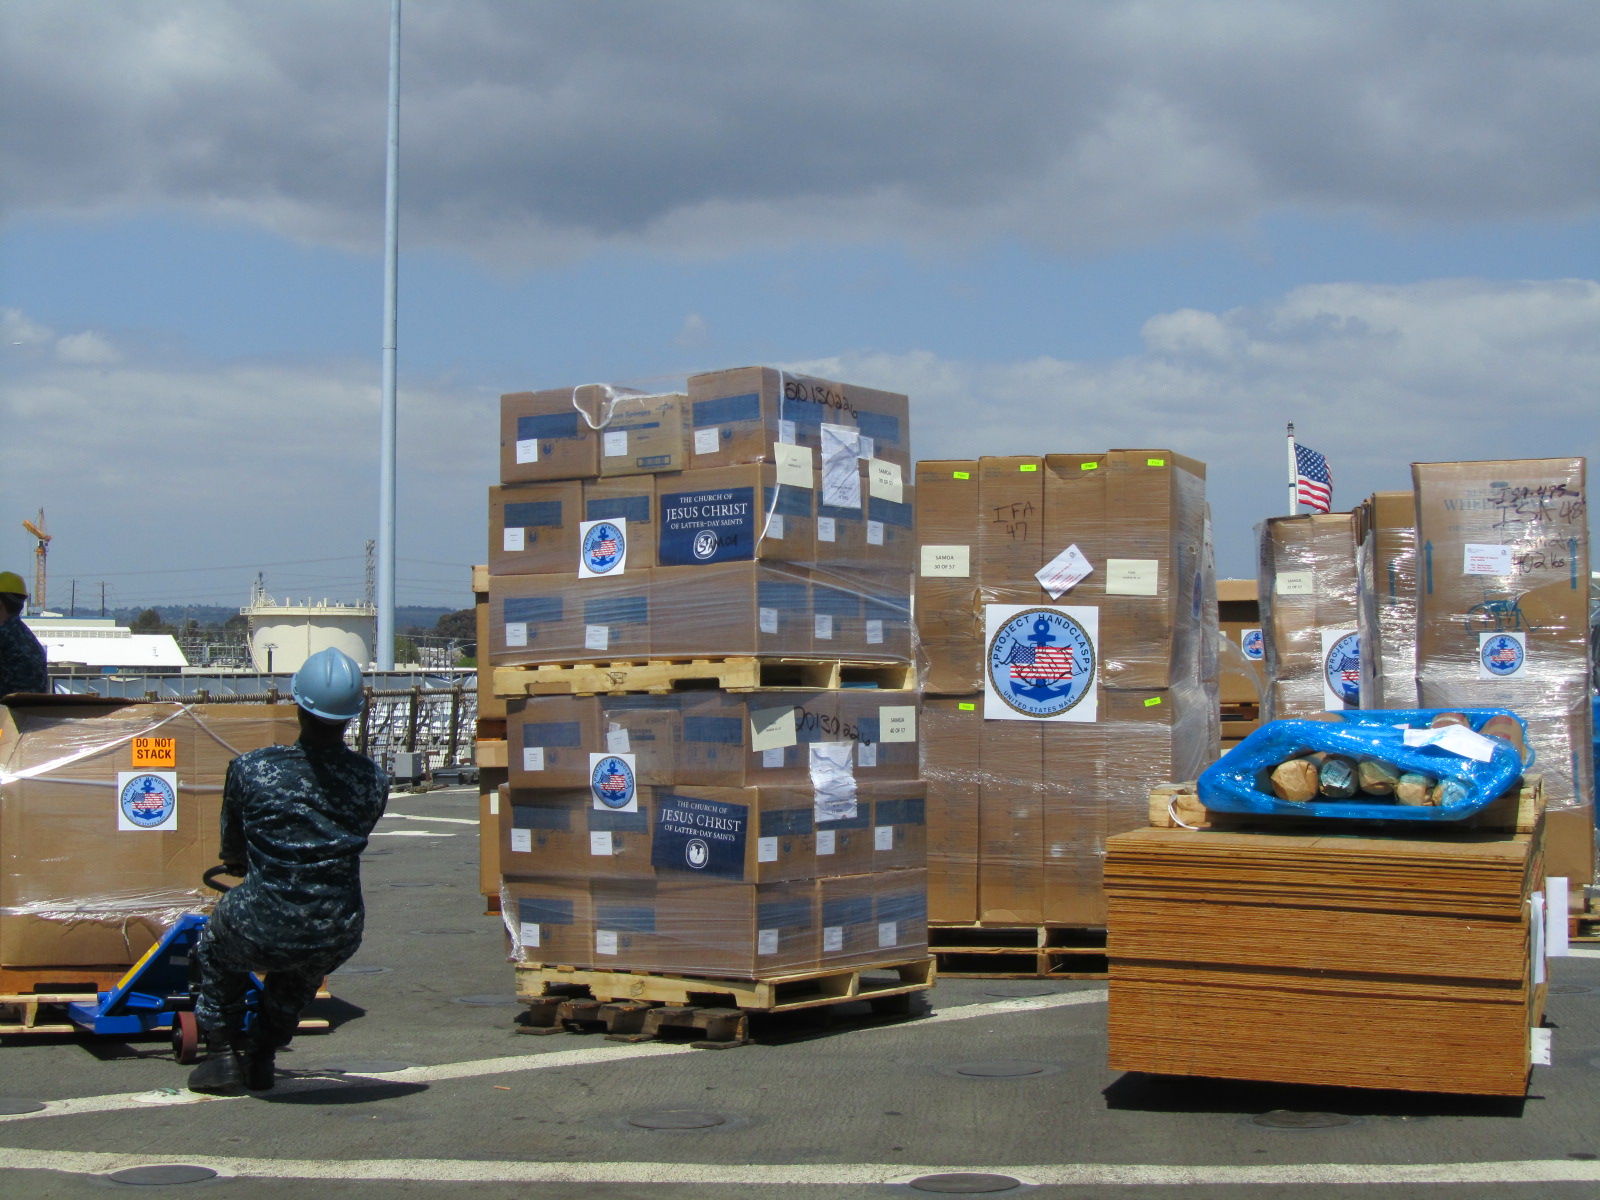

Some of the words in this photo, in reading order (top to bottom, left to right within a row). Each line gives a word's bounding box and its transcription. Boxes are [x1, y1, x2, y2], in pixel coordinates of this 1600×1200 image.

[785, 382, 858, 419] 20130226
[694, 495, 721, 503] CHURCH
[666, 506, 698, 523] JESUS
[701, 503, 748, 517] CHRIST
[681, 520, 719, 529] LATTER-DAY
[1006, 522, 1028, 541] 47
[1550, 552, 1566, 569] lbs
[993, 616, 1029, 660] PROJECT
[1038, 614, 1090, 664] HANDCLASP
[1329, 636, 1353, 669] PROJECT
[1004, 690, 1027, 710] UNITED
[1059, 695, 1076, 709] NAVY
[793, 706, 871, 746] 20130226
[136, 738, 148, 747] DO
[154, 738, 171, 747] NOT
[136, 749, 172, 759] STACK
[593, 759, 608, 781] PROJECT
[123, 778, 142, 801] PROJECT
[146, 777, 172, 801] HANDCLASP
[677, 800, 689, 808] THE
[690, 803, 717, 813] CHURCH
[661, 808, 693, 824] JESUS
[696, 814, 741, 832] CHRIST
[674, 826, 712, 838] LATTER-DAY
[713, 832, 735, 841] SAINTS
